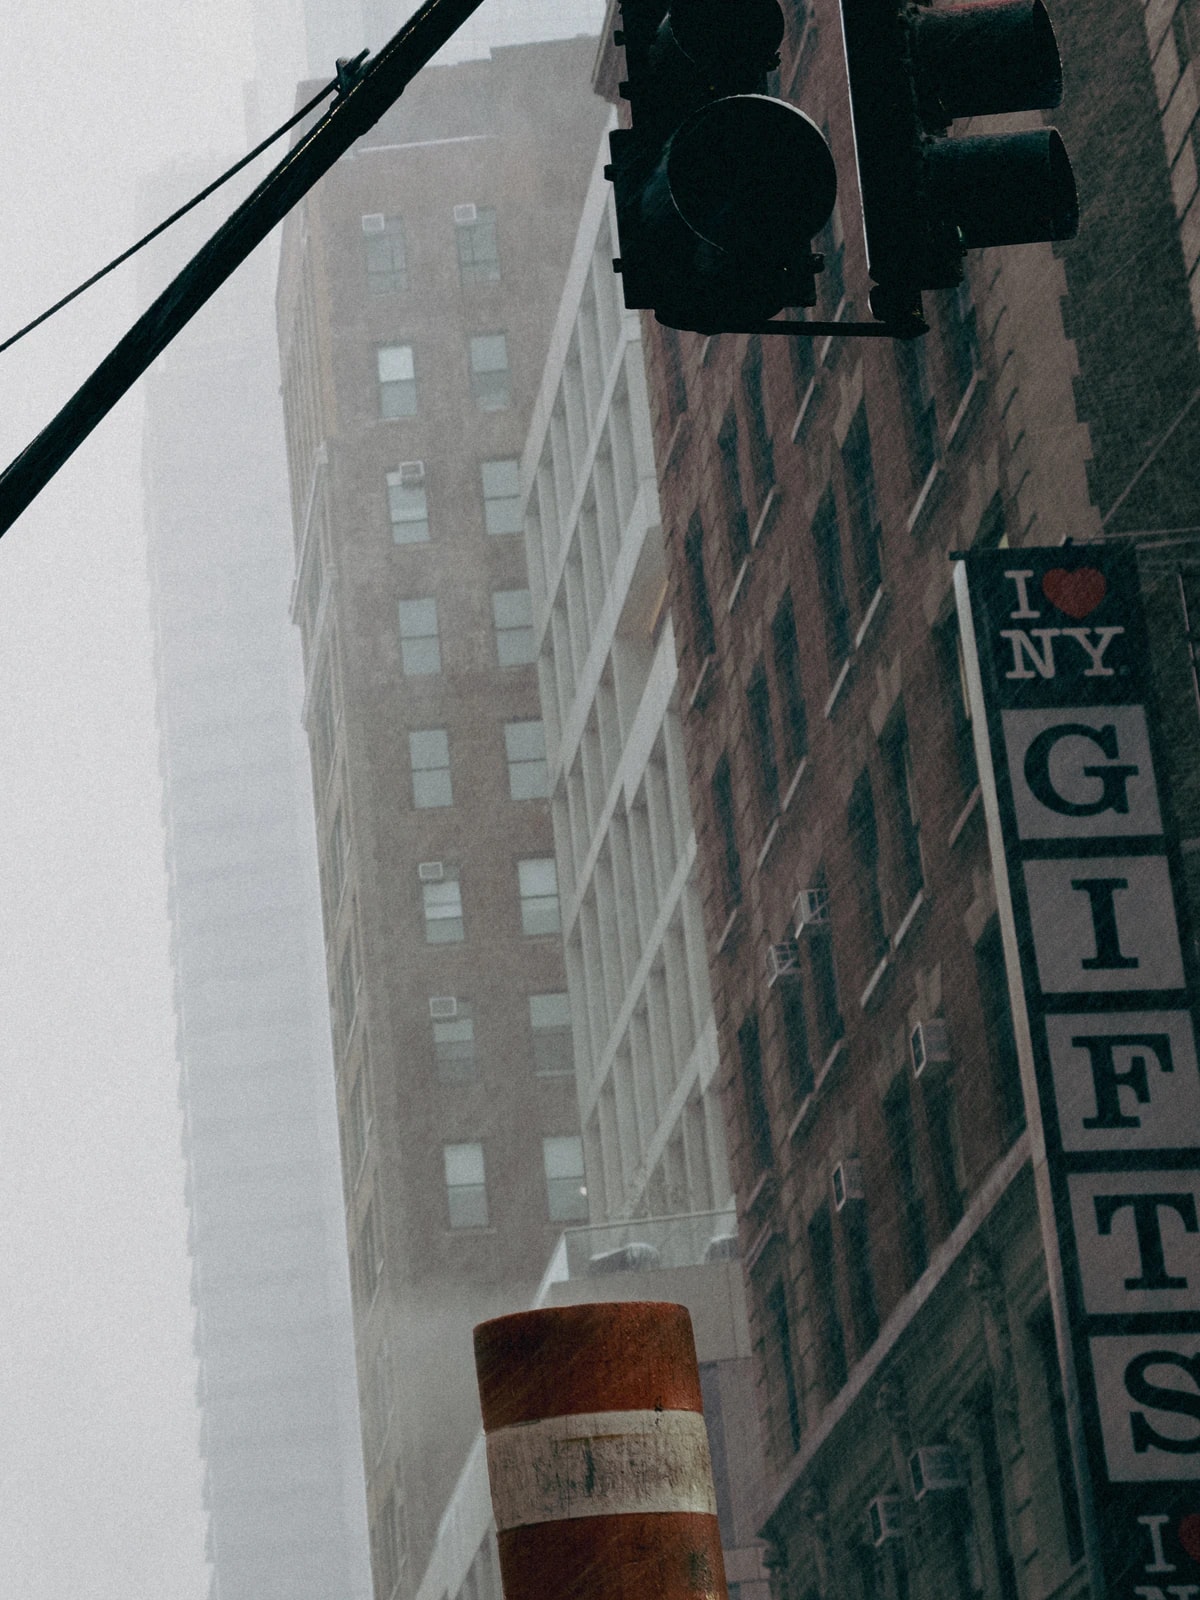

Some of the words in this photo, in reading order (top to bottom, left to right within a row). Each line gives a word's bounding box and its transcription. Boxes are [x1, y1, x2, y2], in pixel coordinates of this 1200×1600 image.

[1004, 569, 1041, 619] I
[999, 625, 1125, 679] NY
[1137, 1514, 1176, 1572] I
